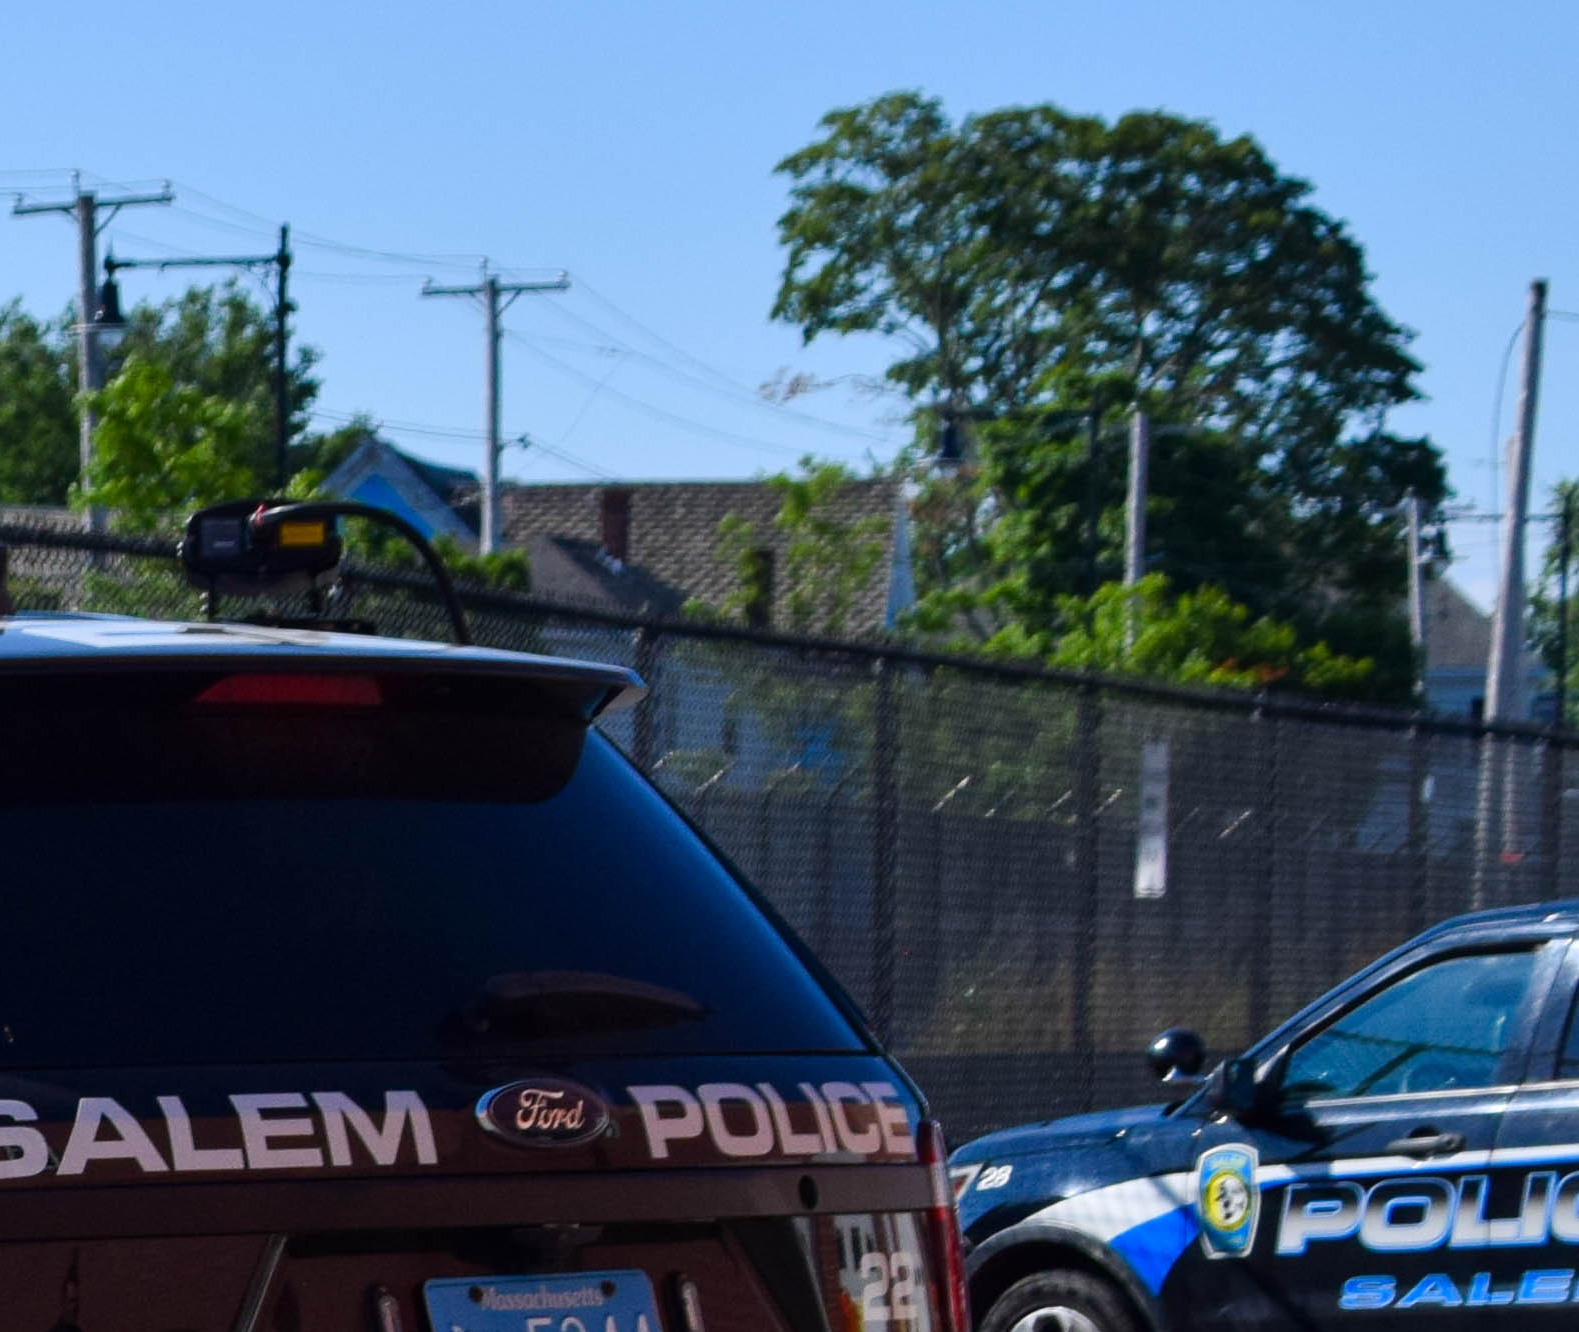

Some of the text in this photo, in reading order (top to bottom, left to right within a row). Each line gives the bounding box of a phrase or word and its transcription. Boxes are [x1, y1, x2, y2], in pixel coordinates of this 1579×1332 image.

[516, 1089, 585, 1131] Ford
[628, 1081, 917, 1159] POLICE
[861, 1251, 918, 1321] 22
[1337, 1268, 1579, 1310] SALE
